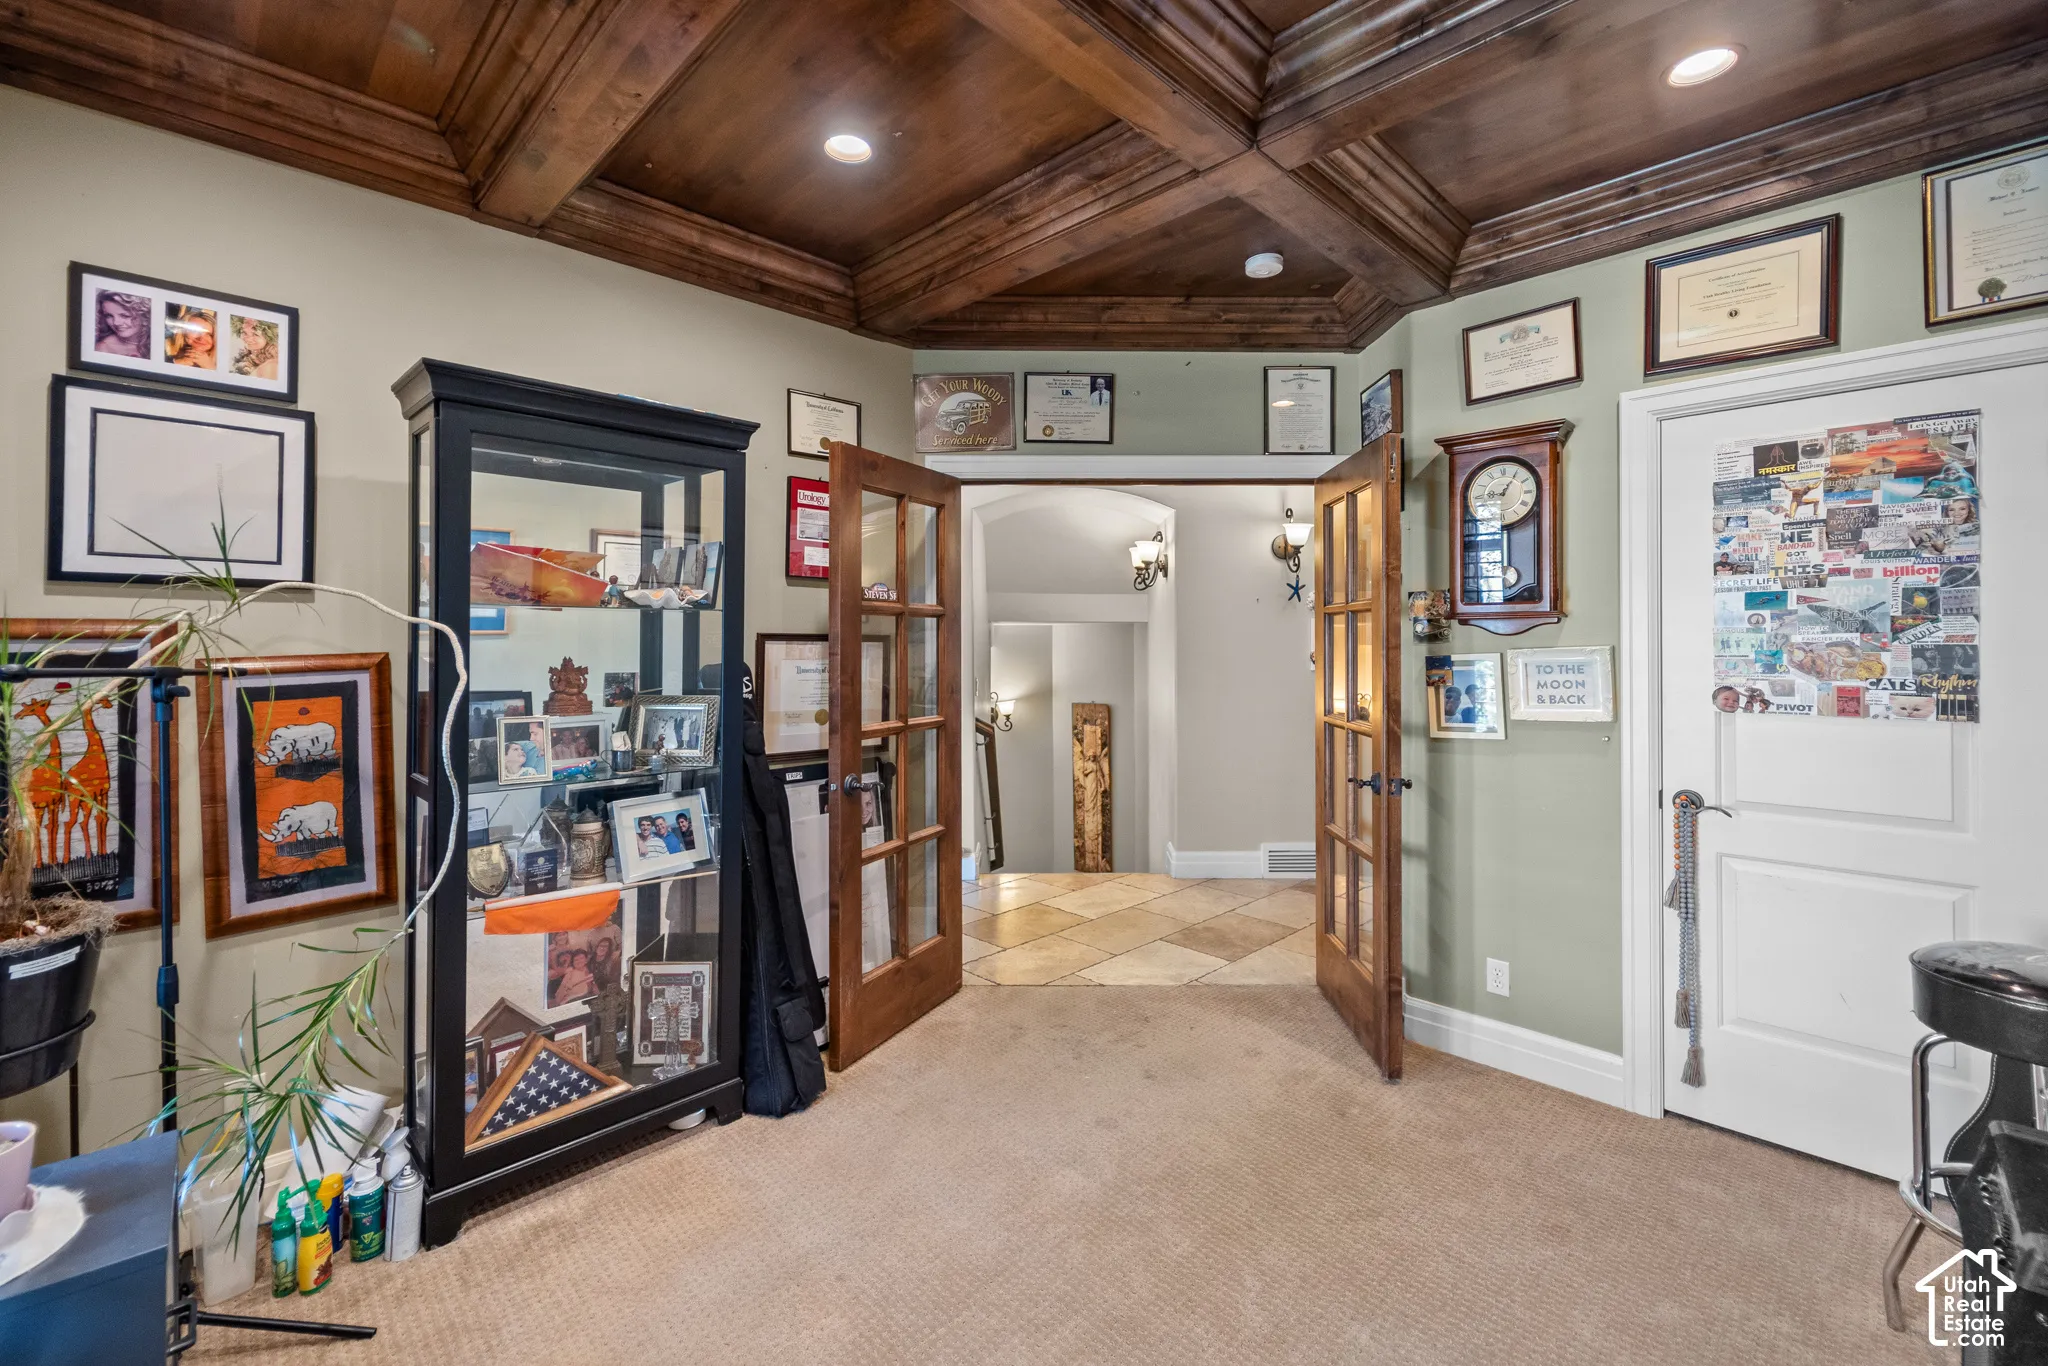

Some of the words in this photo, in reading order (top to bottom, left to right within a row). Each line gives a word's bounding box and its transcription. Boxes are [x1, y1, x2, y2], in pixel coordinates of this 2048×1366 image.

[920, 390, 941, 408] GET
[939, 379, 968, 394] YOUR
[973, 378, 1007, 406] WOODY
[1925, 422, 1978, 434] ESCAPES
[932, 433, 973, 447] Serviced
[974, 434, 998, 445] here
[1758, 463, 1796, 475] नमस्कार
[799, 492, 826, 505] Urology
[1880, 501, 1932, 510] NAVIGATING
[1906, 506, 1937, 514] SWEET
[1780, 530, 1813, 544] WE
[1828, 532, 1852, 541] Spell
[1864, 529, 1901, 539] MORE
[1777, 542, 1815, 551] BAND-AID
[1738, 554, 1759, 562] CALL
[1877, 550, 1907, 558] Perfect
[1770, 564, 1826, 576] THIS
[1883, 565, 1939, 577] billion
[1714, 578, 1755, 587] SECRET
[864, 589, 888, 599] STEVEN
[1820, 609, 1876, 620] SPEAK
[1836, 620, 1860, 631] UP
[795, 666, 822, 675] University
[1536, 664, 1554, 675] TO
[1558, 664, 1585, 675] THE
[1537, 679, 1586, 690] MOON
[1866, 679, 1916, 690] CATS
[1920, 674, 1977, 693] Rhythm
[1537, 694, 1546, 705] &
[1549, 694, 1586, 705] BACK
[1776, 704, 1813, 712] PIVOT
